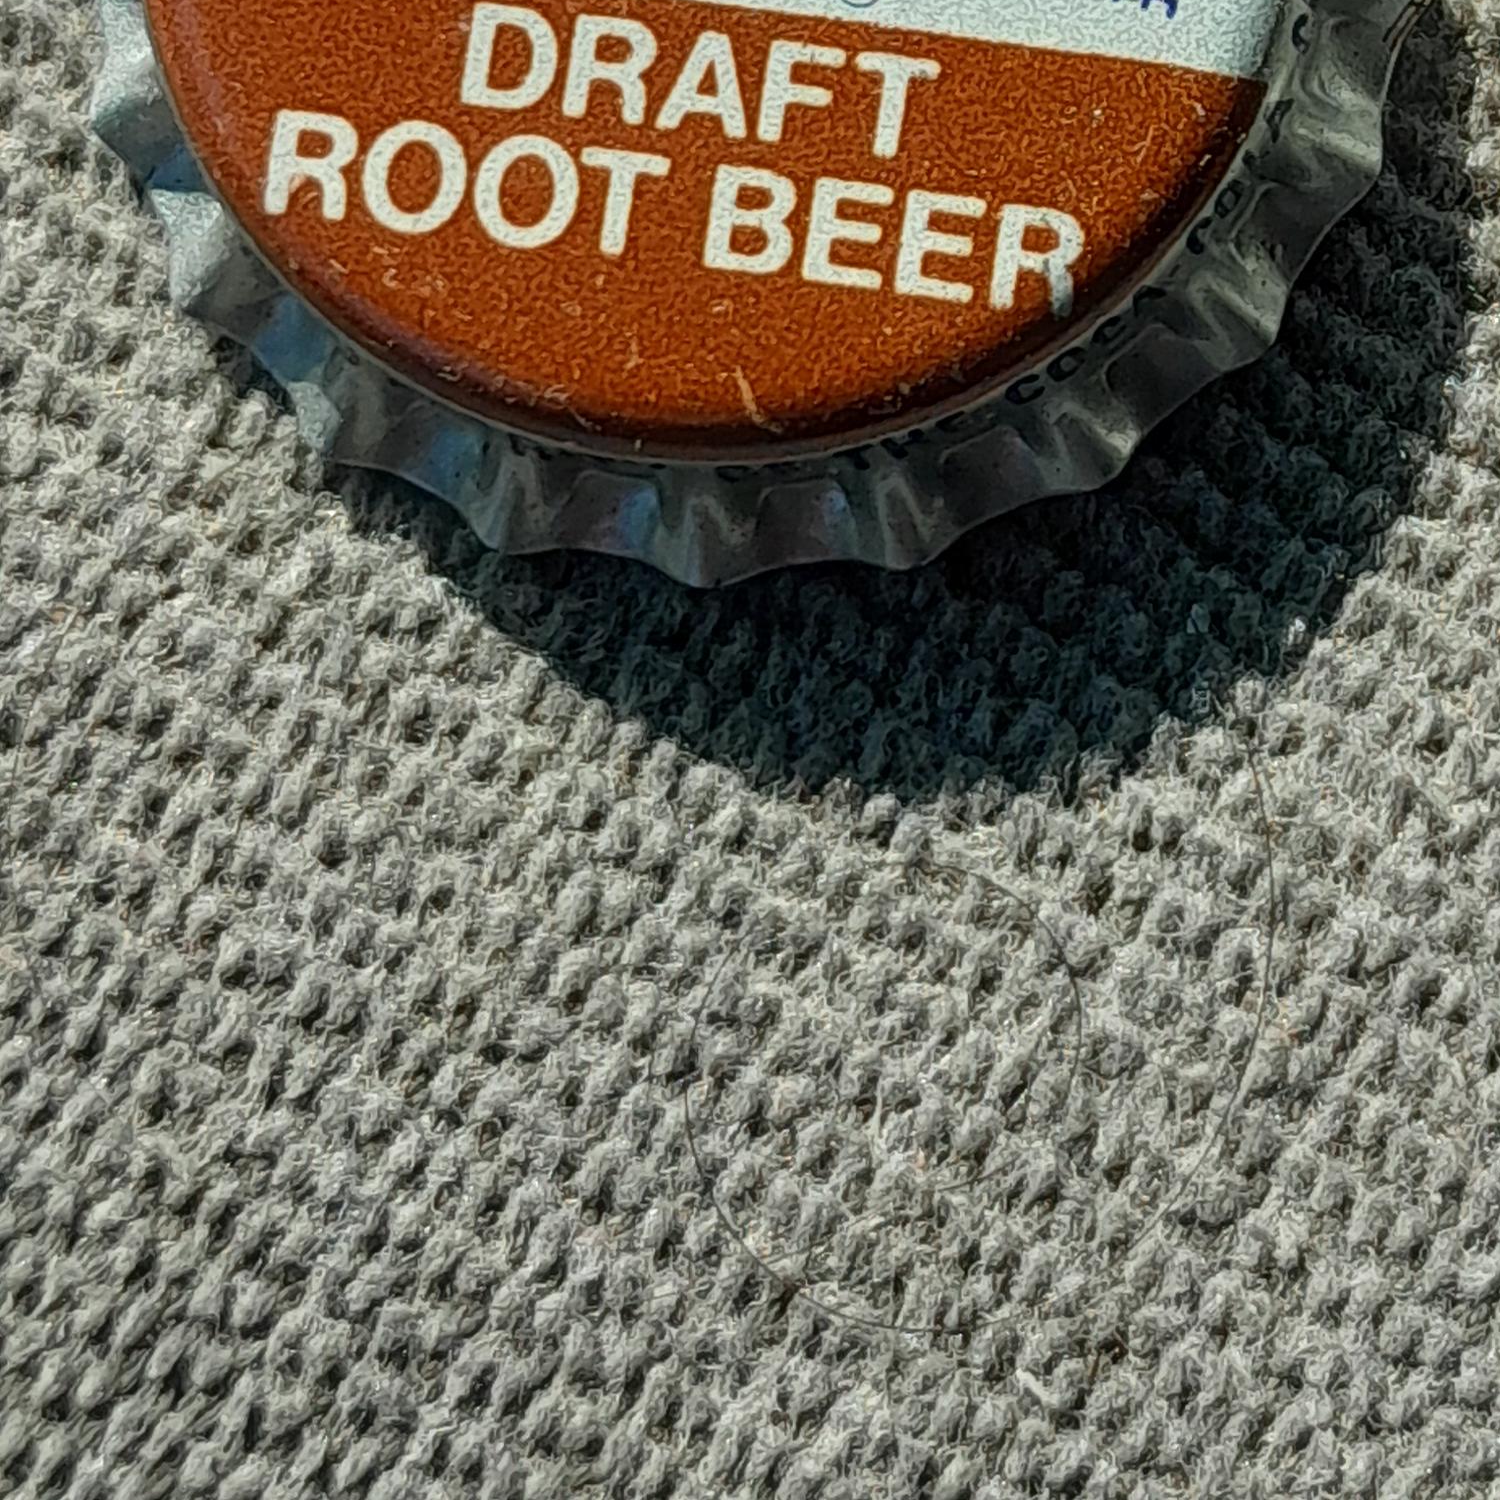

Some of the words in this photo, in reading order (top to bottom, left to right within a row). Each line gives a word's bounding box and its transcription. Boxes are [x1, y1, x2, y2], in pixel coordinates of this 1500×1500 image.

[459, 1, 942, 160] DRAFT
[262, 109, 672, 258] ROOT
[703, 163, 1086, 320] BEER
